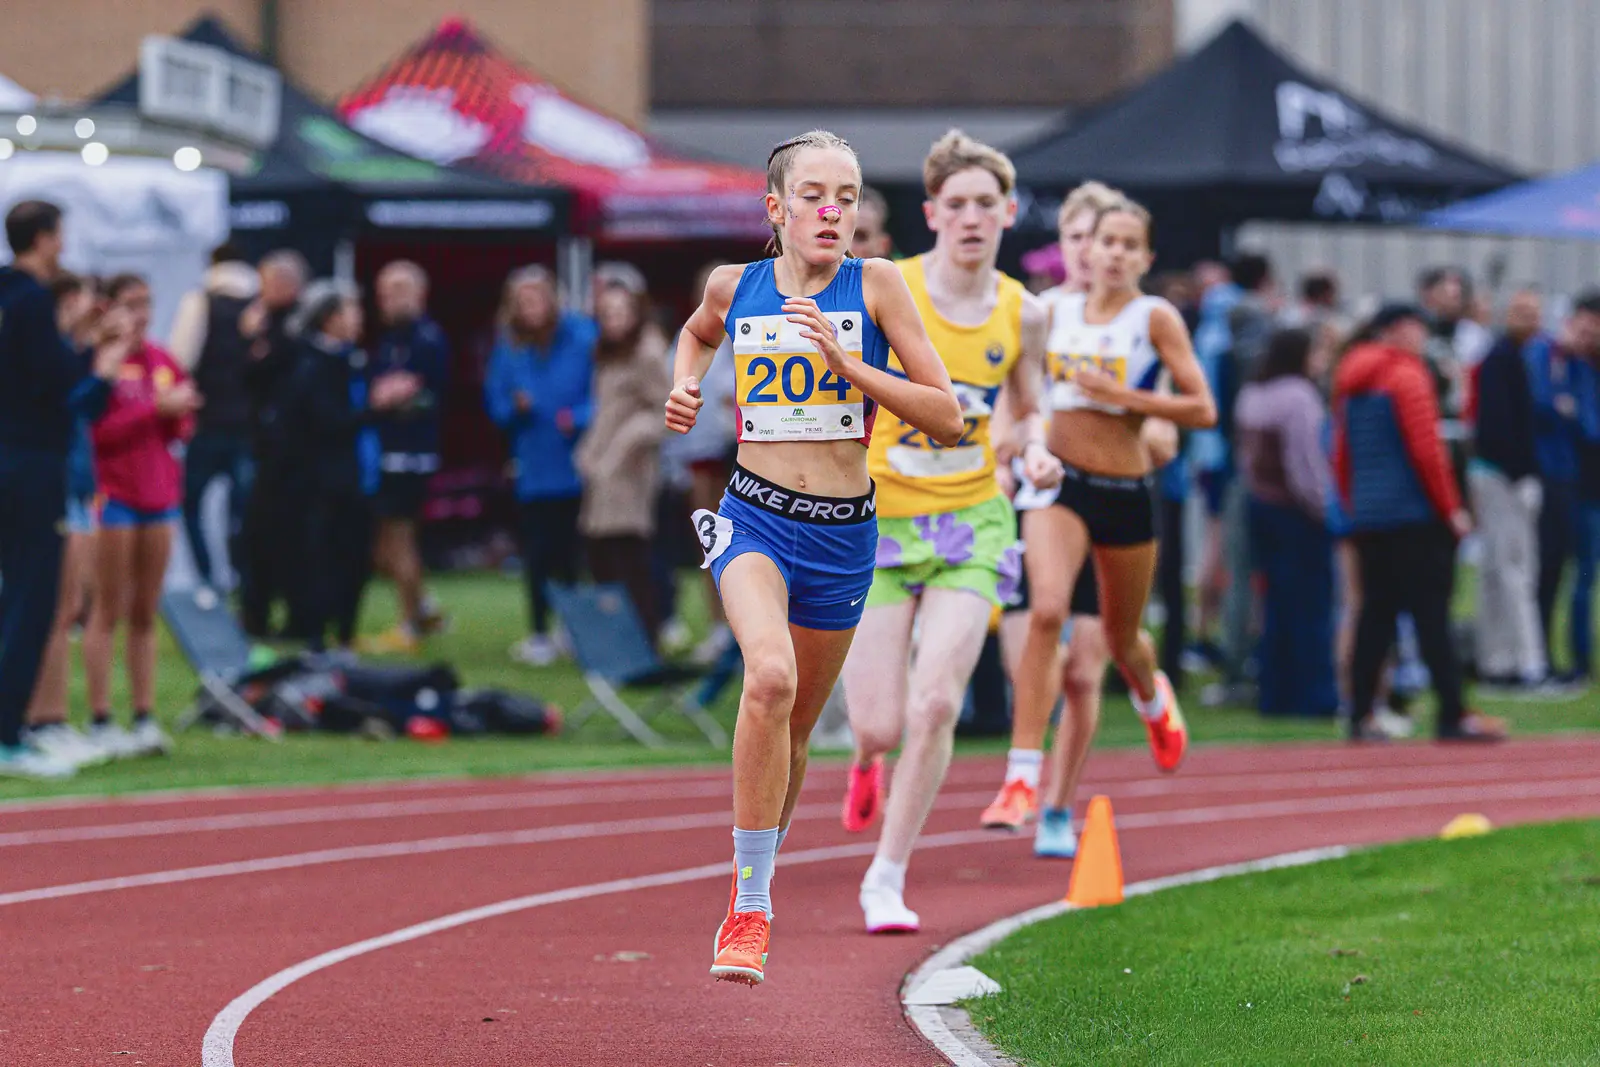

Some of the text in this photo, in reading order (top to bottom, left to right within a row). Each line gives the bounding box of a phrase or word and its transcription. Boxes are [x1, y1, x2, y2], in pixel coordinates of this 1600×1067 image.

[747, 356, 851, 403] 204
[899, 418, 978, 449] 22
[730, 470, 789, 510] NIKE
[789, 498, 854, 519] PRO
[698, 514, 718, 554] 3
